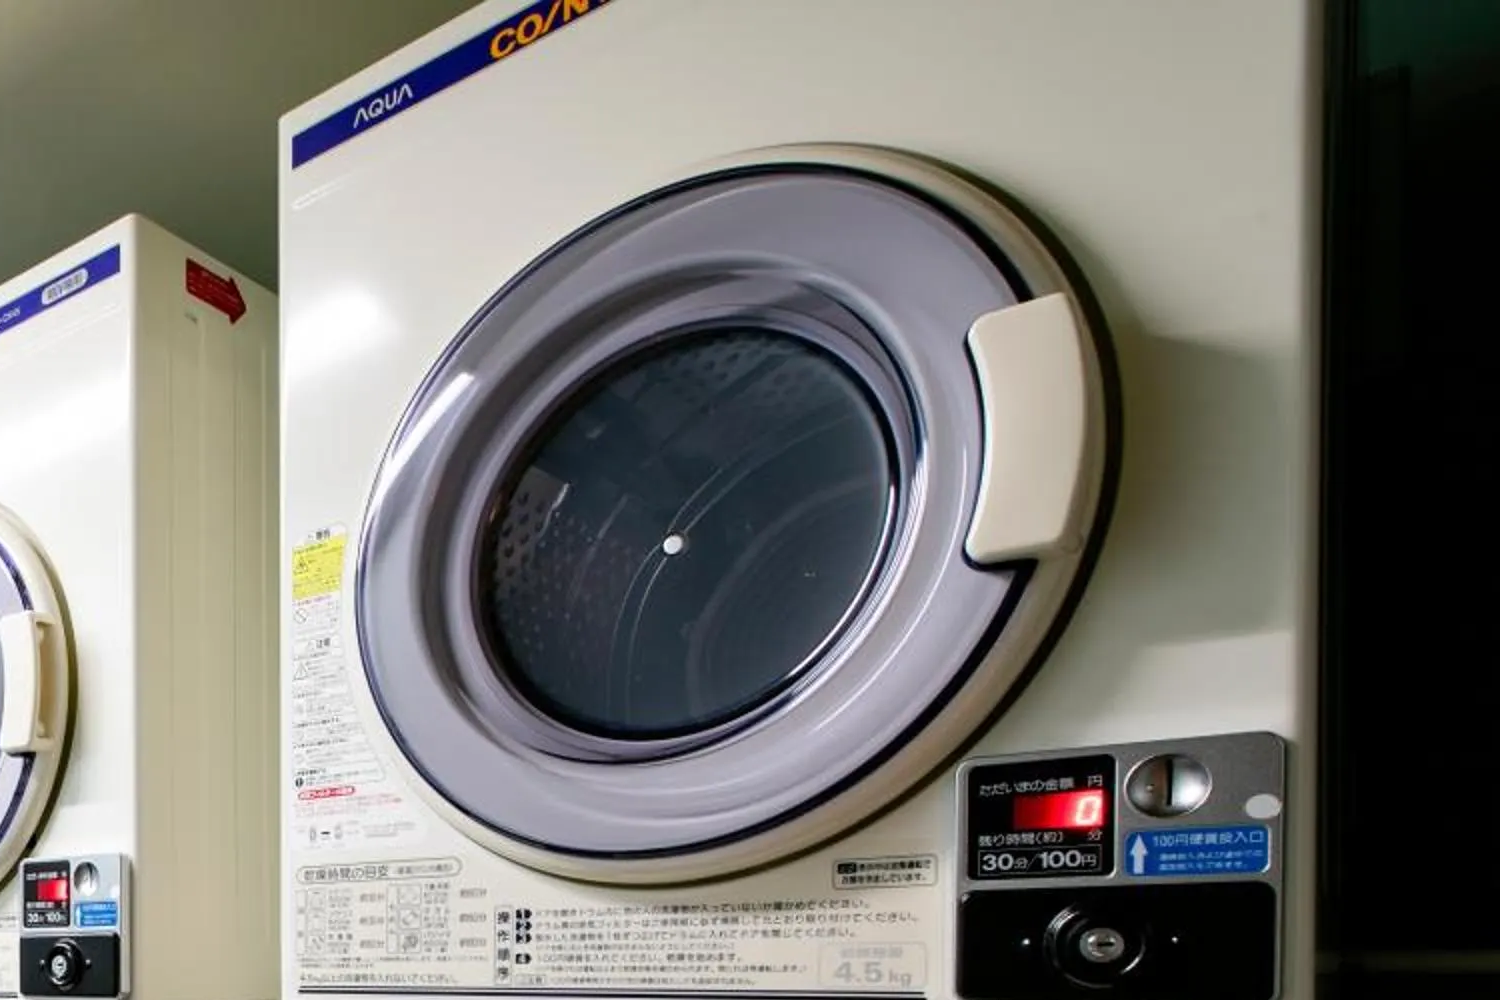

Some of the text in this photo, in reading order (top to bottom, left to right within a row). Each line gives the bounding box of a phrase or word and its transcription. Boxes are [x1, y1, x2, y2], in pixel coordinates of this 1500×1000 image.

[353, 83, 413, 128] AQUA
[1088, 775, 1102, 787] 円
[1076, 796, 1101, 826] 0
